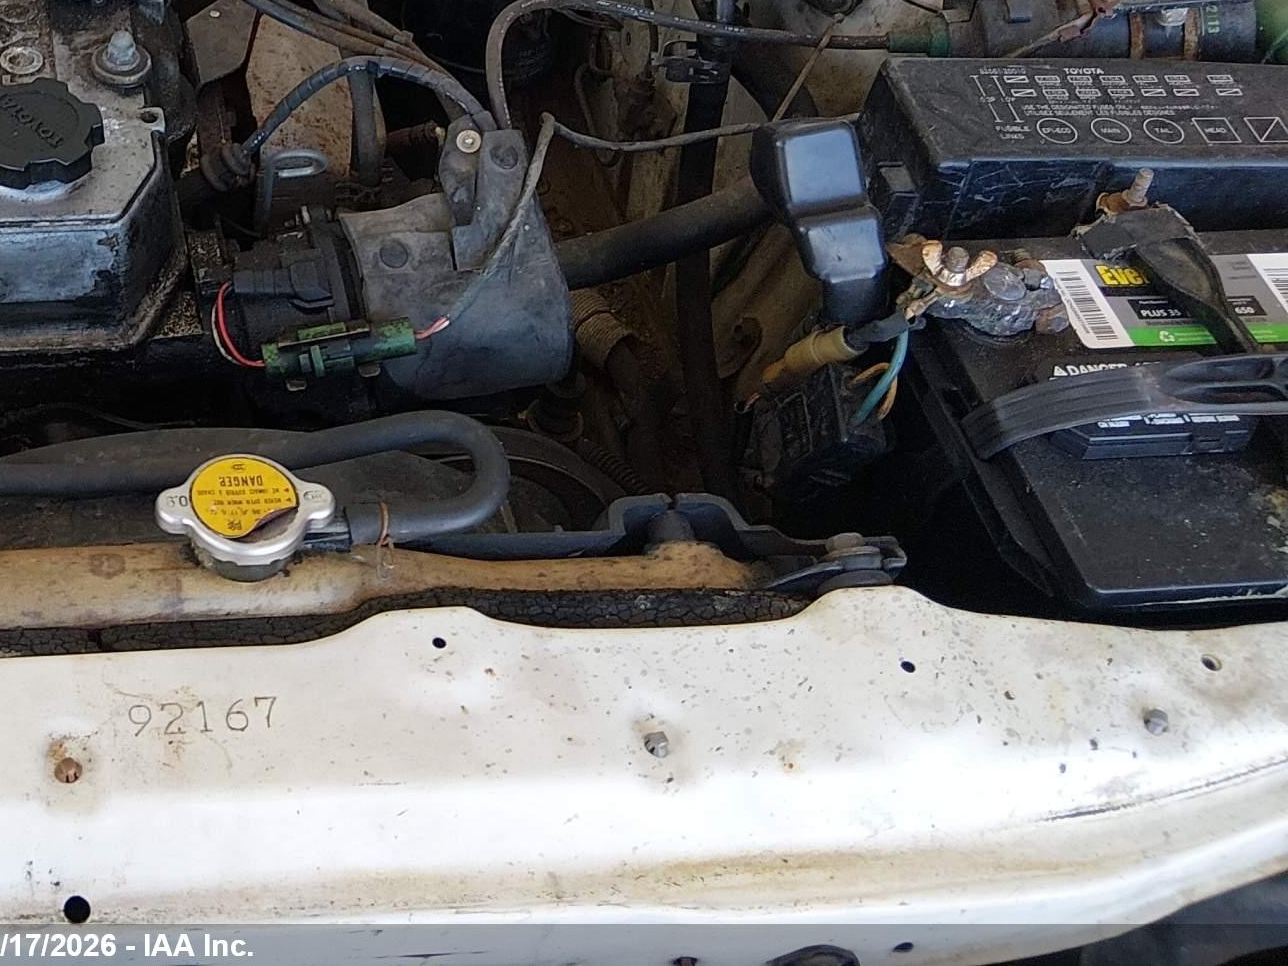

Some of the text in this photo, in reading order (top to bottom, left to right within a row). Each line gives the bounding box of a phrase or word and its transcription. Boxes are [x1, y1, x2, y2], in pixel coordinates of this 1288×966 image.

[1063, 67, 1105, 75] TOYOTA
[0, 96, 69, 148] TOYOTA
[1140, 309, 1167, 317] PLUS
[1234, 306, 1255, 315] 650
[218, 476, 264, 487] DANGER
[127, 695, 278, 737] 92167
